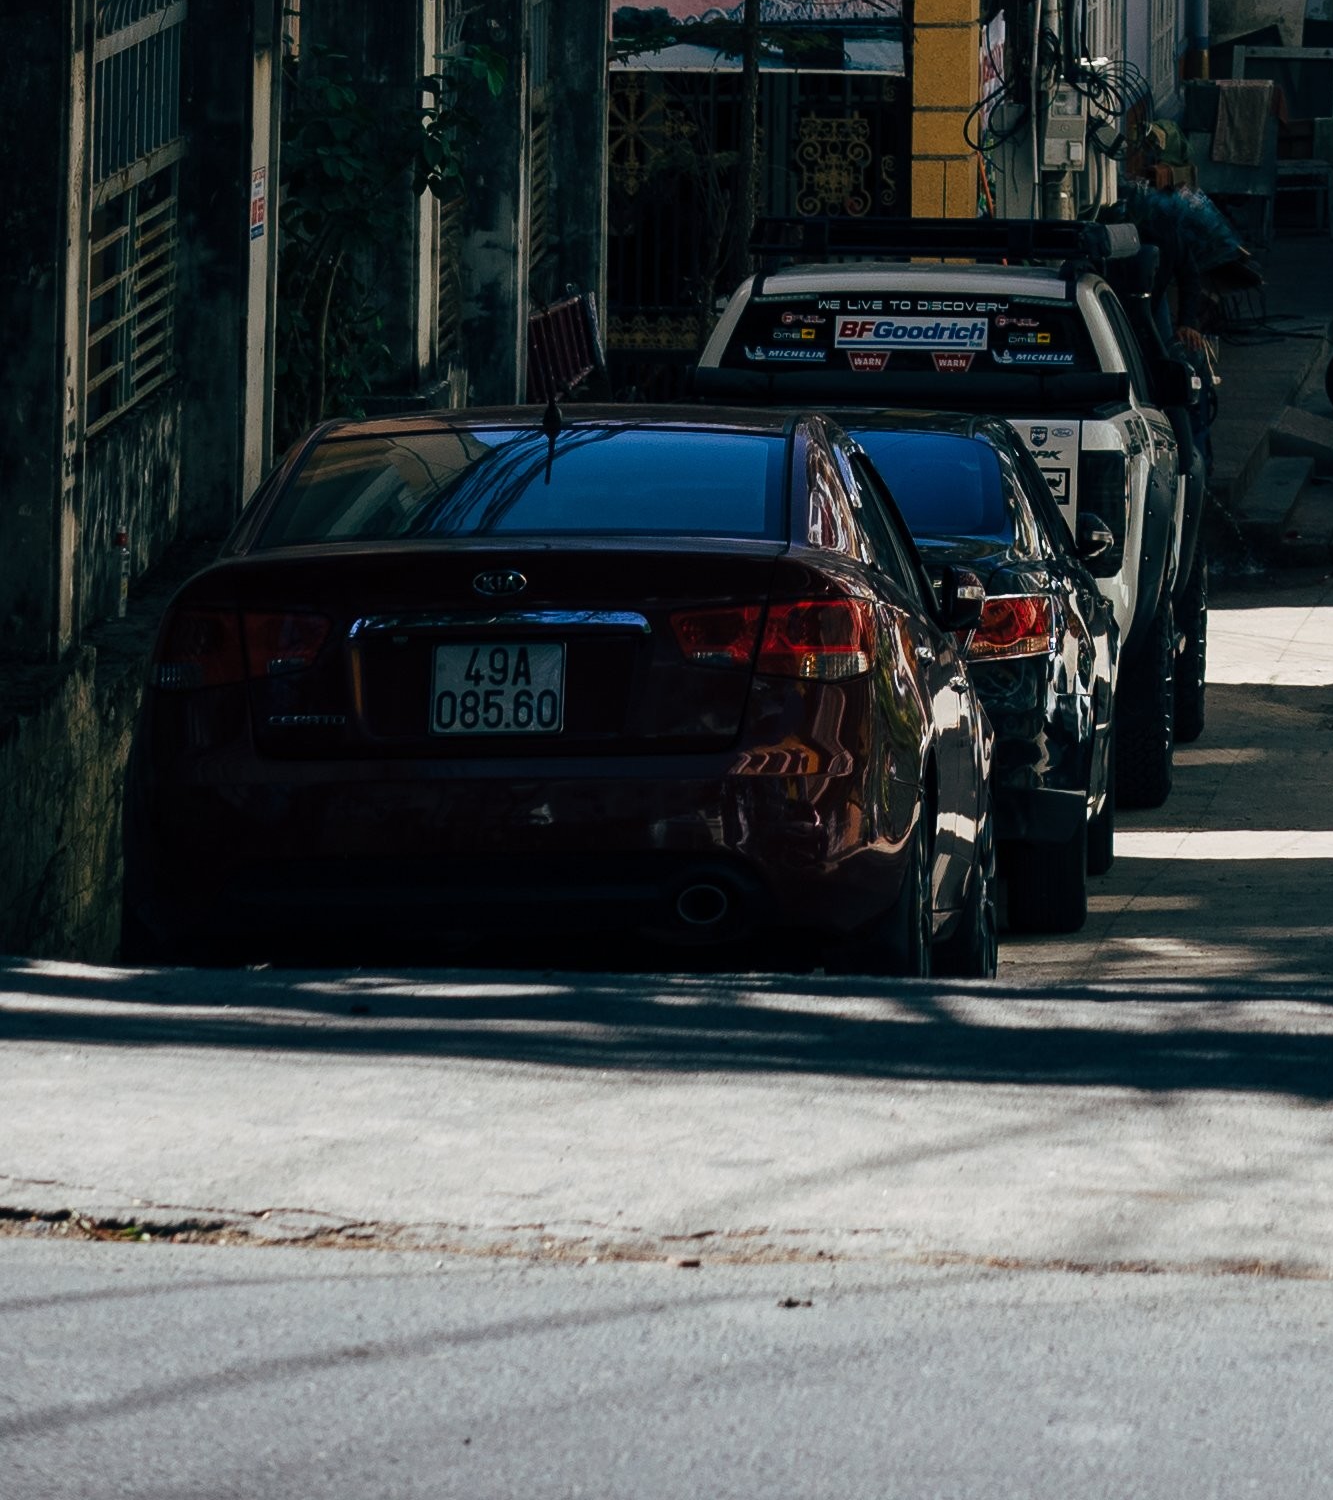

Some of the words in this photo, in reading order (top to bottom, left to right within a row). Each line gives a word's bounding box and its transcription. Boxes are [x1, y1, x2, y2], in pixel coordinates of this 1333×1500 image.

[818, 300, 841, 310] WE
[889, 300, 912, 310] TO
[839, 320, 986, 342] BFGoodrich
[768, 349, 826, 360] MICHELIN
[854, 354, 884, 367] WARN
[1015, 353, 1074, 362] MICHELIN
[939, 356, 968, 368] WARN
[481, 575, 518, 591] KIA
[464, 646, 533, 687] 49A
[436, 689, 558, 730] 085.60
